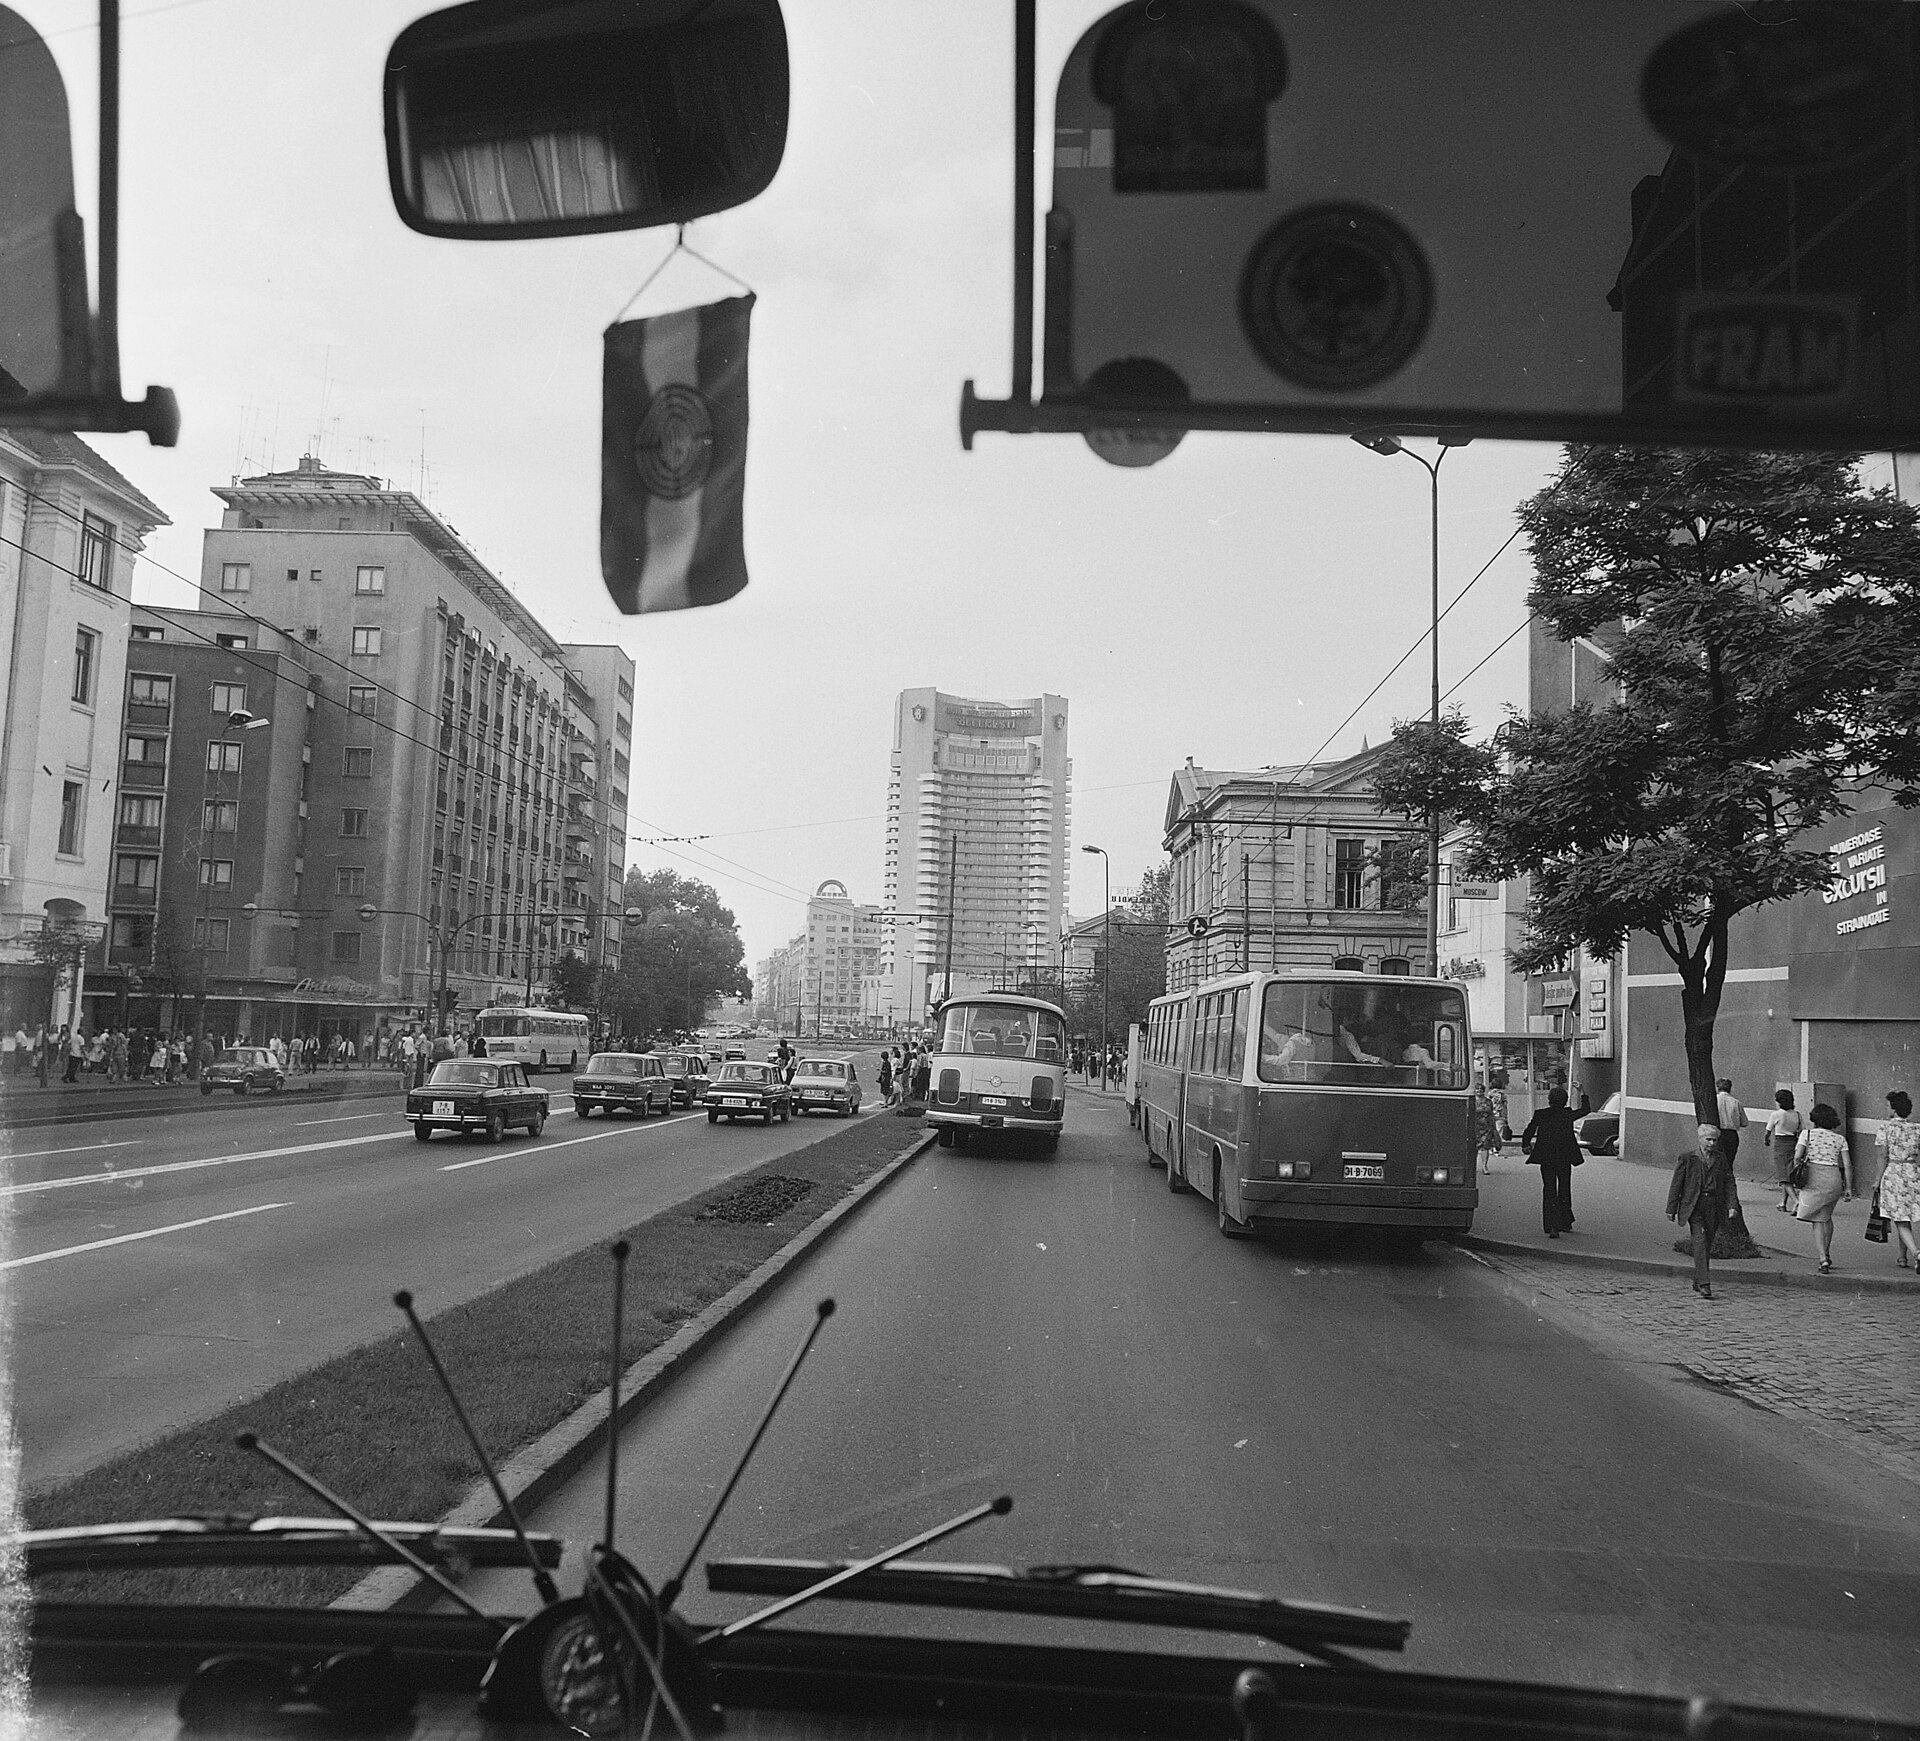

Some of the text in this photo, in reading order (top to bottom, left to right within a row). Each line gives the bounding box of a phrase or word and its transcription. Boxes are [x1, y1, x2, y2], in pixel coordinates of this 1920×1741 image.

[1690, 324, 1842, 389] FRAM
[1829, 826, 1882, 858] NUMEROASE
[1847, 845, 1885, 869] VARIATE
[1463, 888, 1487, 896] MOSCOW
[1876, 890, 1888, 905] IN
[1837, 908, 1890, 935] STRAINATATE
